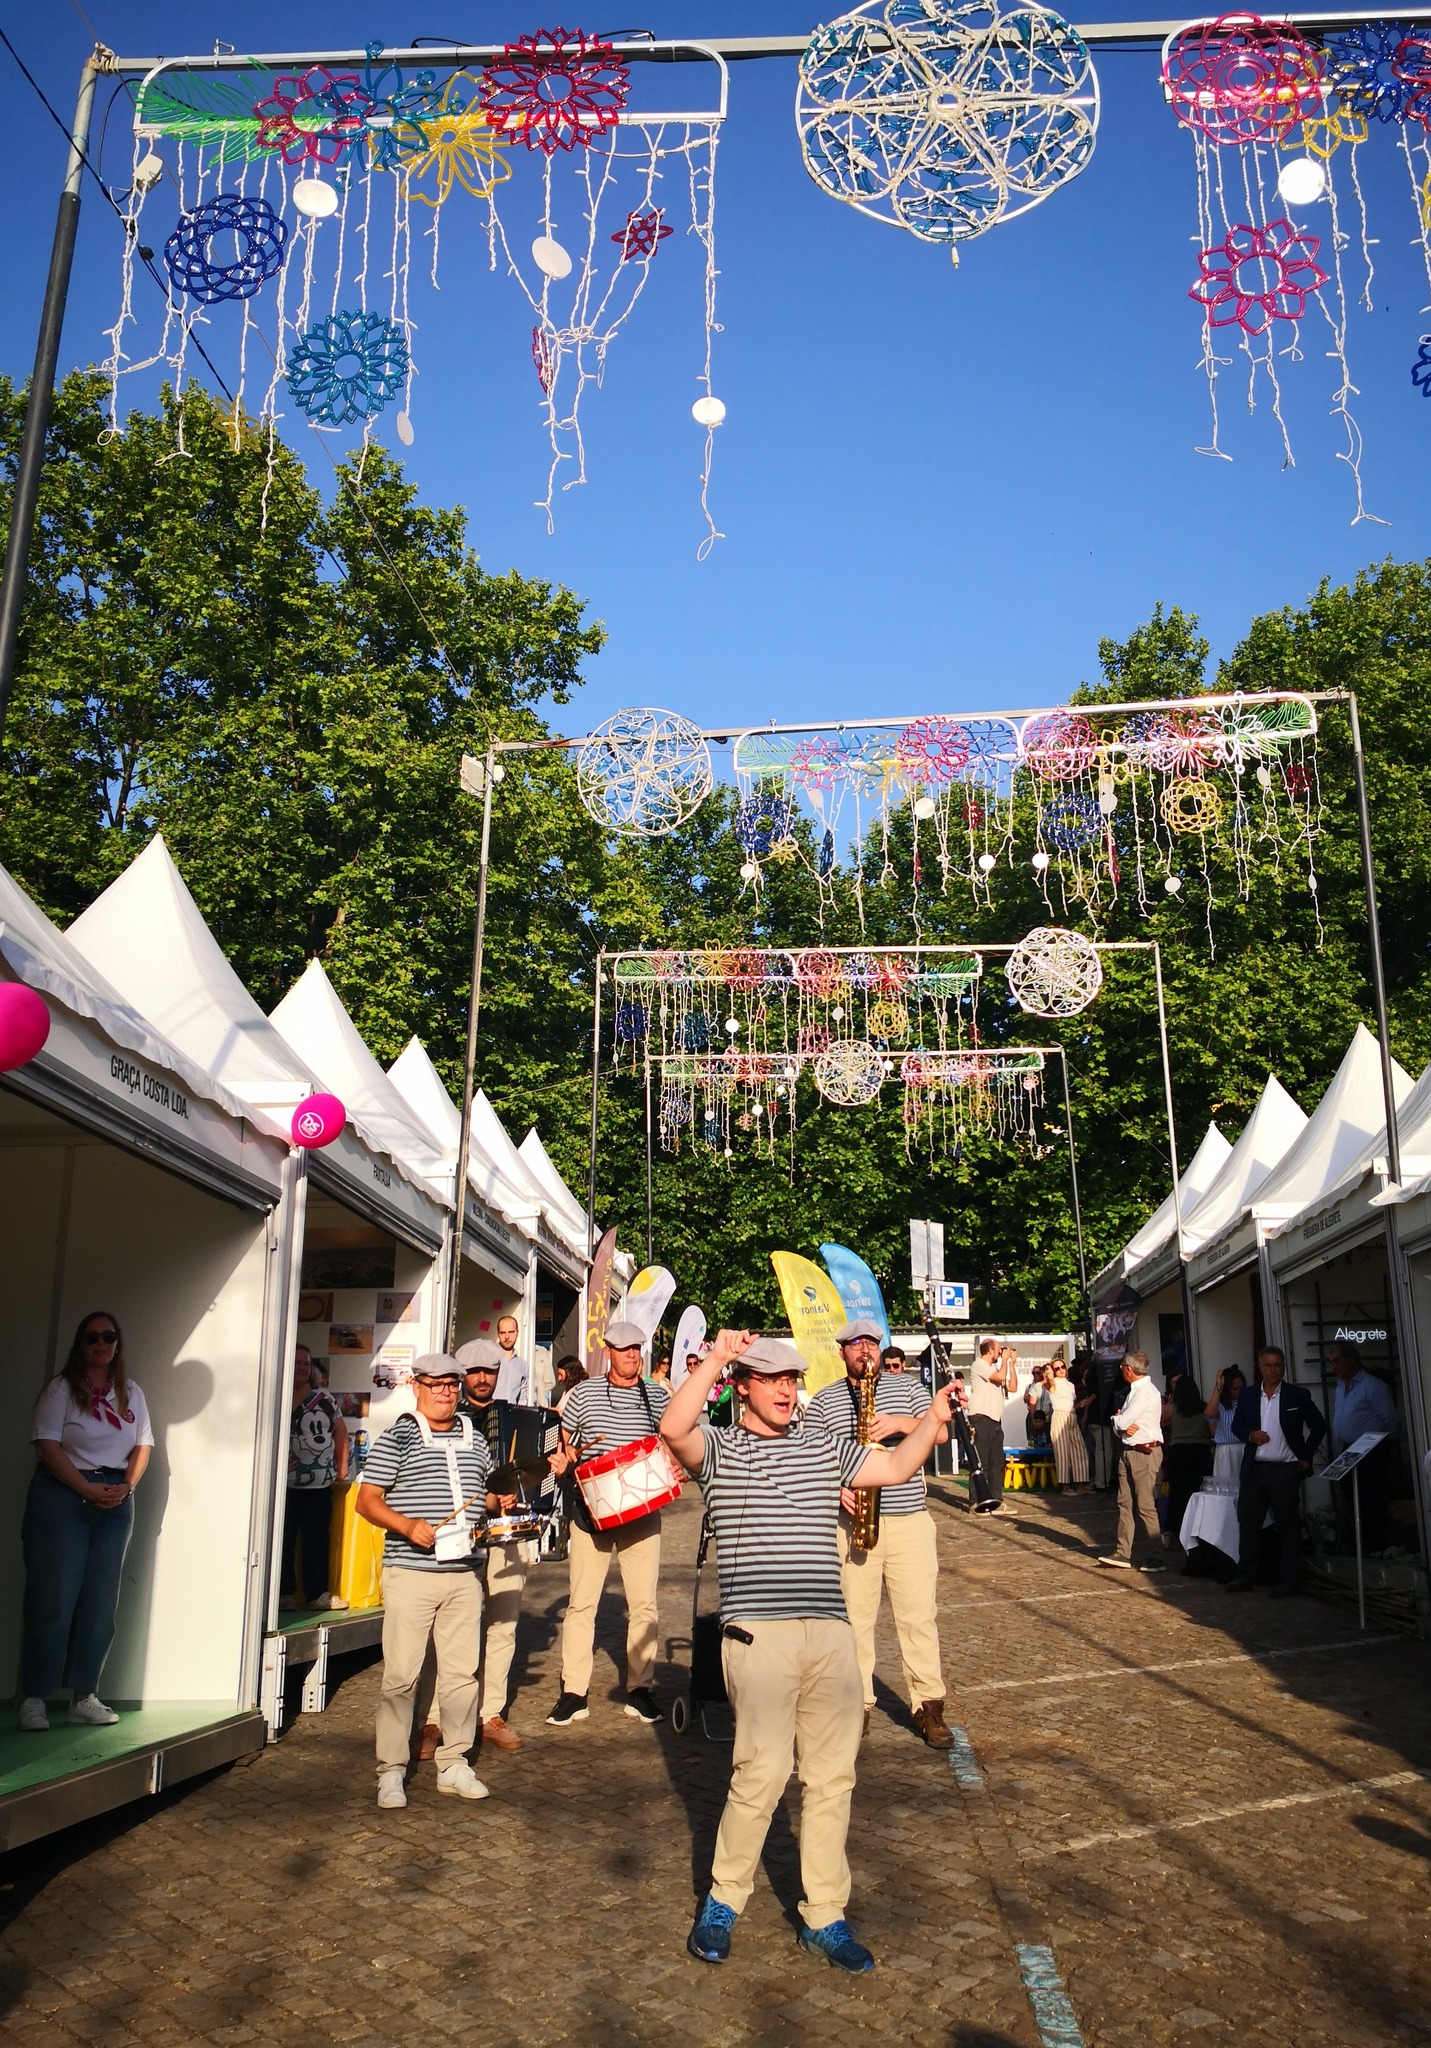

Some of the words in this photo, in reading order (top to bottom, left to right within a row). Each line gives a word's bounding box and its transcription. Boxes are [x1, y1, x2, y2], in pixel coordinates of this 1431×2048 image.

[111, 1055, 141, 1093] GRAÇA
[143, 1074, 169, 1108] COSTA
[172, 1091, 189, 1119] LDA.
[1335, 1327, 1387, 1344] Alegrete
